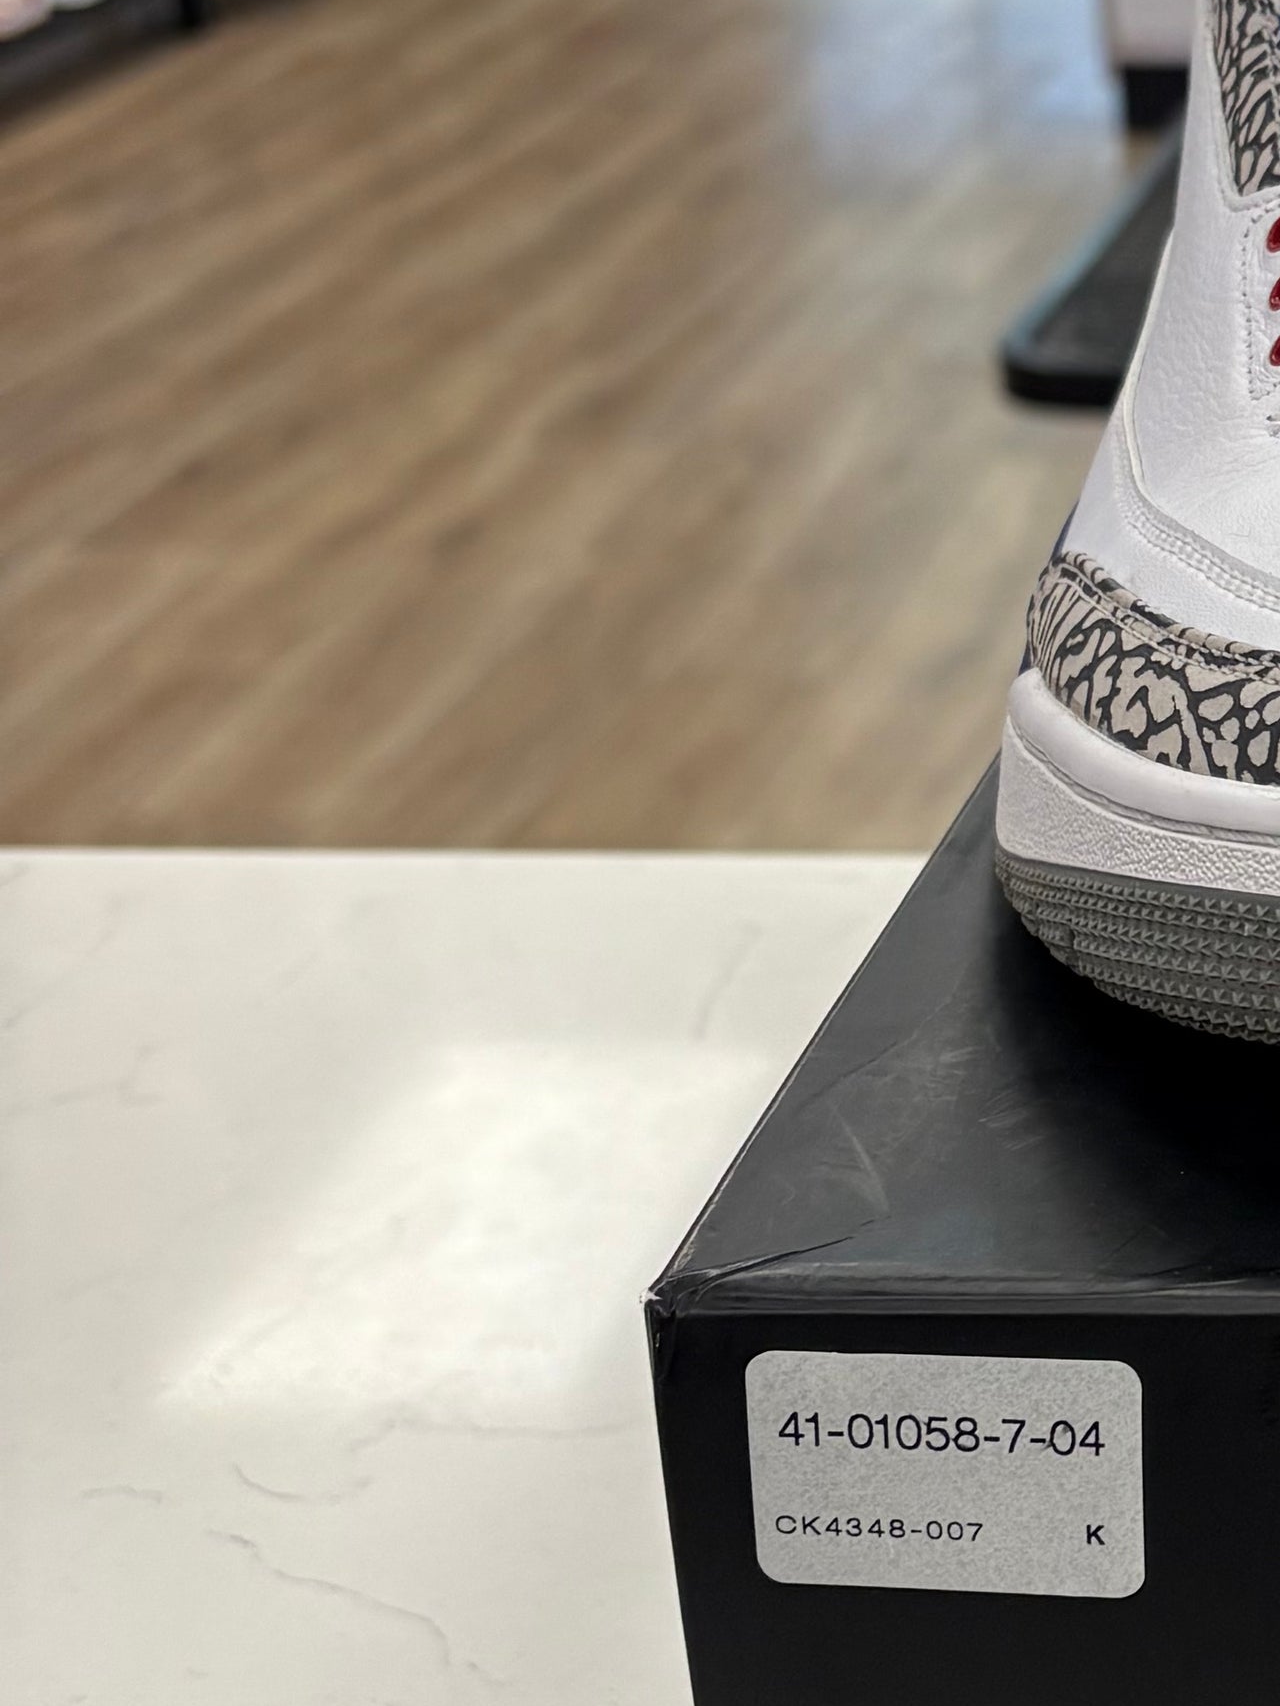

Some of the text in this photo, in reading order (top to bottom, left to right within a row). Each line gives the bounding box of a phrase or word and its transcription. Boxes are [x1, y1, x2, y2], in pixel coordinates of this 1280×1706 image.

[778, 1411, 1105, 1457] 41-01058-7-04
[775, 1515, 1106, 1546] CK4348-007 K
